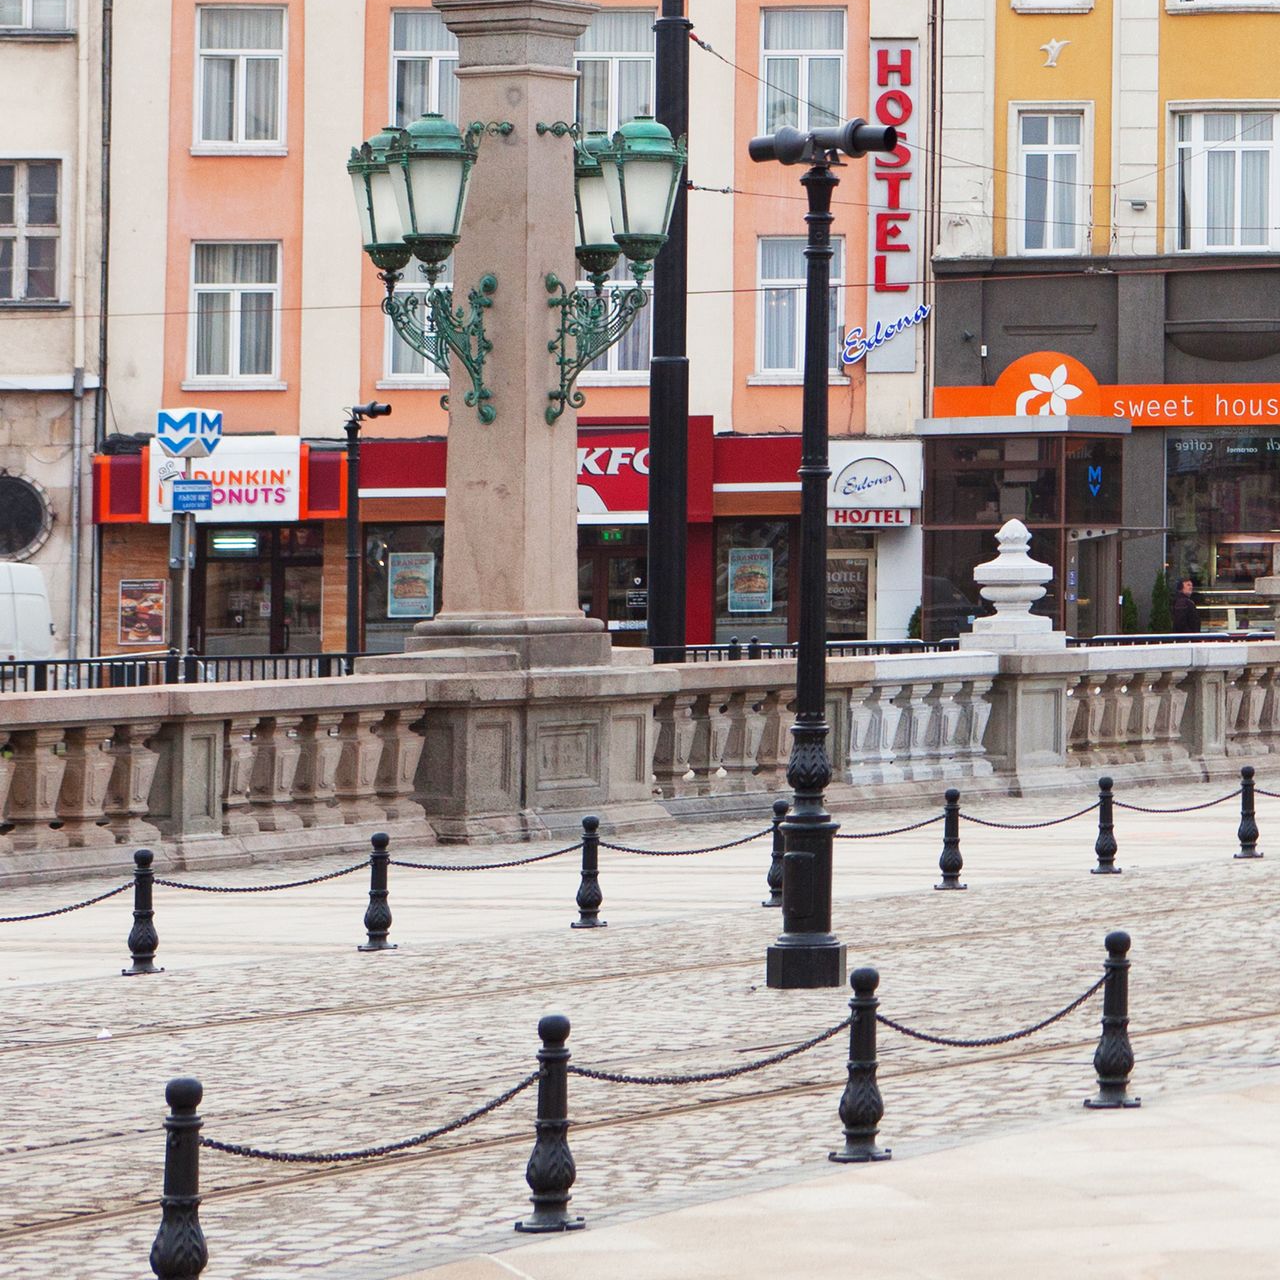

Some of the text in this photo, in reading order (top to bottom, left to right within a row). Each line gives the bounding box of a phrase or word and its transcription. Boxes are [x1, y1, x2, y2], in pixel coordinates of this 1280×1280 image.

[874, 49, 913, 292] HOSTEL
[842, 303, 932, 364] Edona
[1113, 395, 1194, 417] sweet
[194, 469, 291, 486] DUNKIN'
[212, 487, 286, 504] ONUTS
[834, 509, 904, 524] HOSTEL
